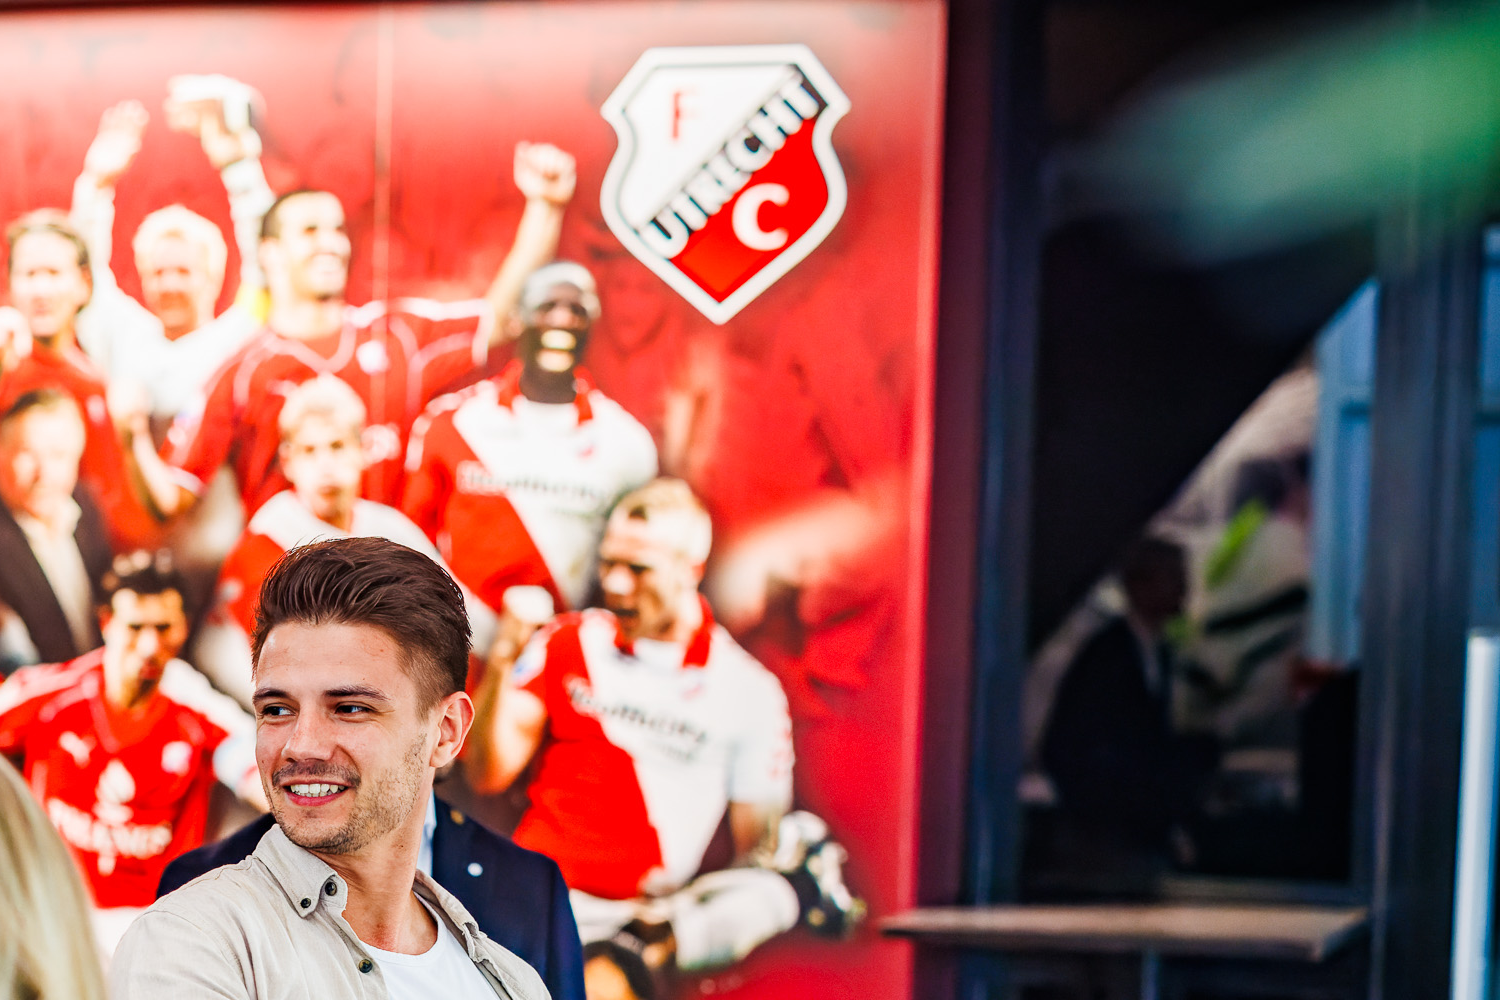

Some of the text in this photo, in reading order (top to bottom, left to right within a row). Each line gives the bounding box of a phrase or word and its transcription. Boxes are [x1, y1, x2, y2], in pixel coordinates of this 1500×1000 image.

[670, 84, 703, 141] F
[639, 70, 820, 260] UTRECHT
[731, 182, 790, 252] C
